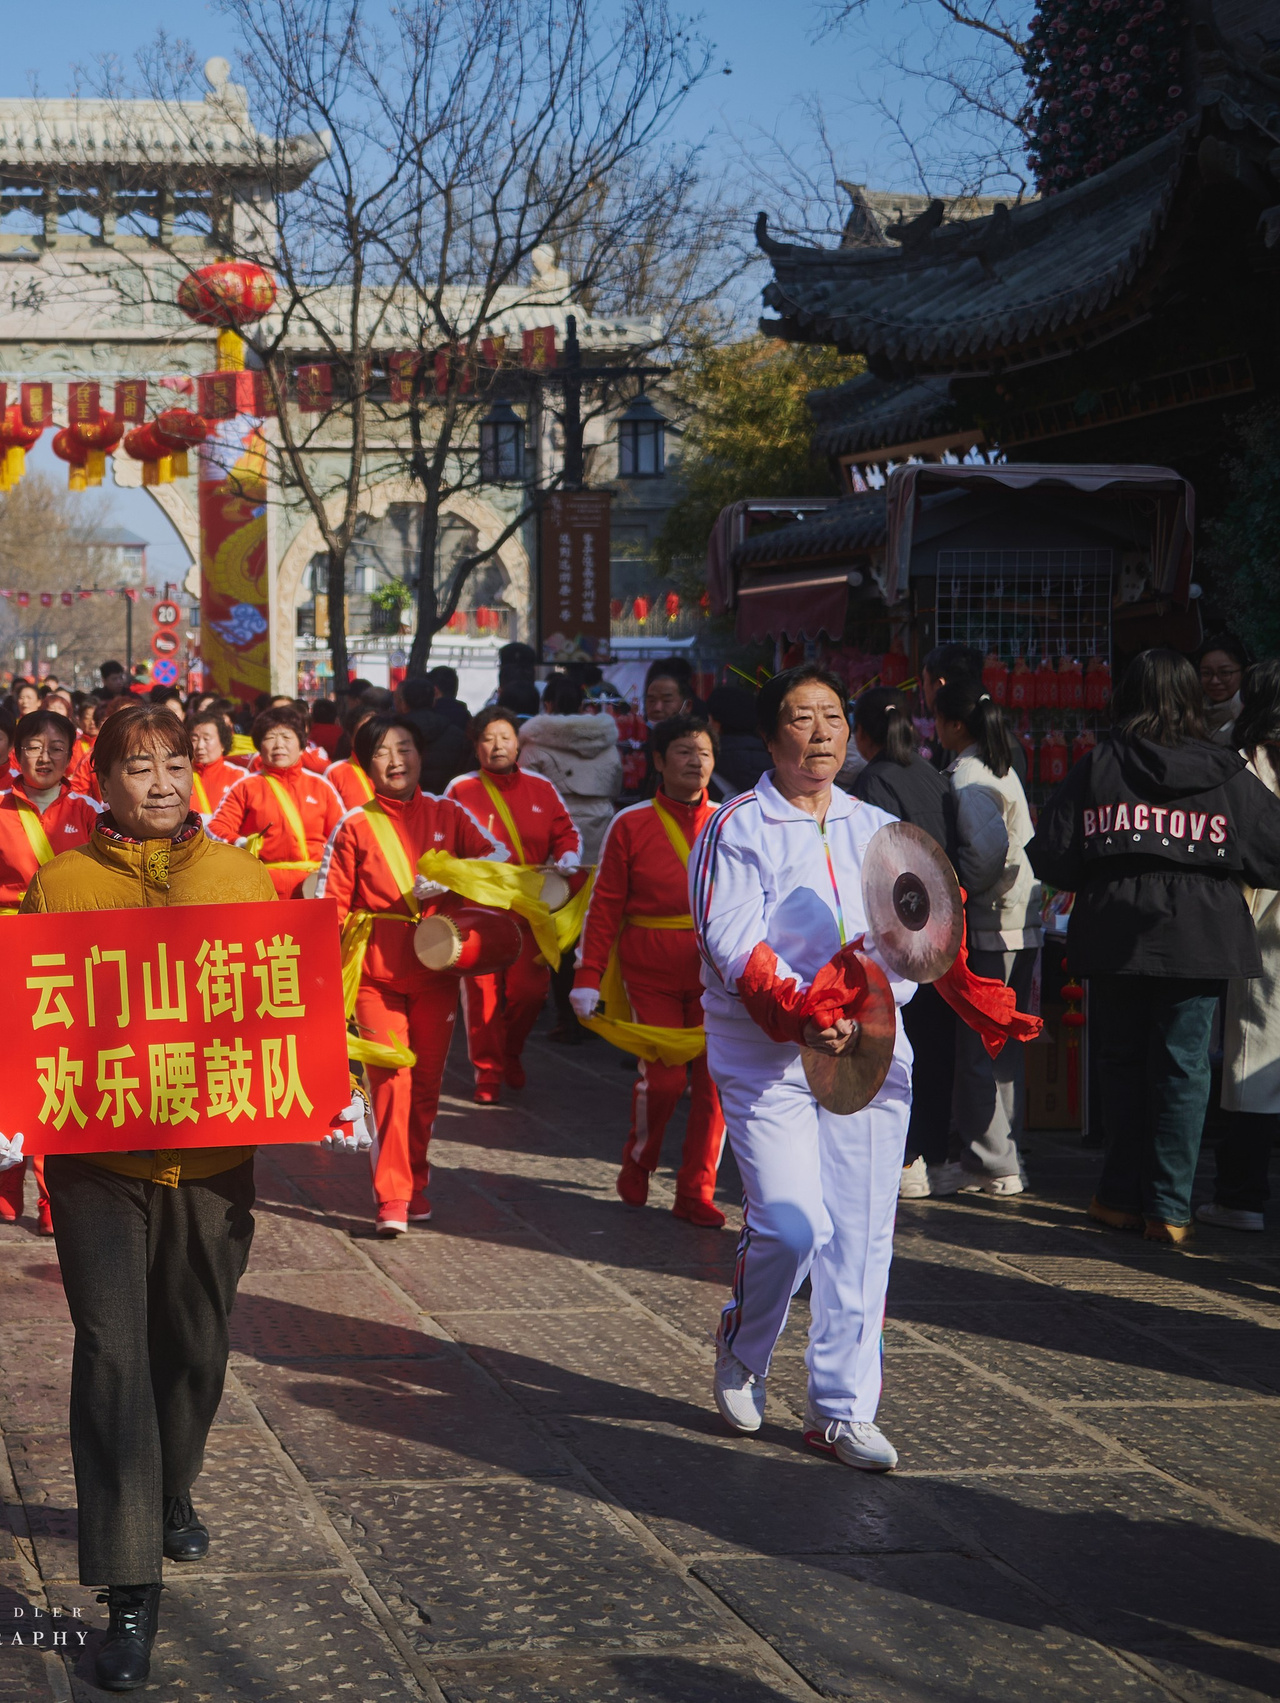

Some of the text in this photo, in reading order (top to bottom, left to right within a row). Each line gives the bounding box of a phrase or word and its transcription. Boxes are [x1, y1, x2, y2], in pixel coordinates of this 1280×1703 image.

[158, 606, 176, 622] 20
[1083, 802, 1228, 844] BUACTOVS
[26, 933, 306, 1031] 云门山街道
[36, 1034, 315, 1131] 欢乐腰鼓队
